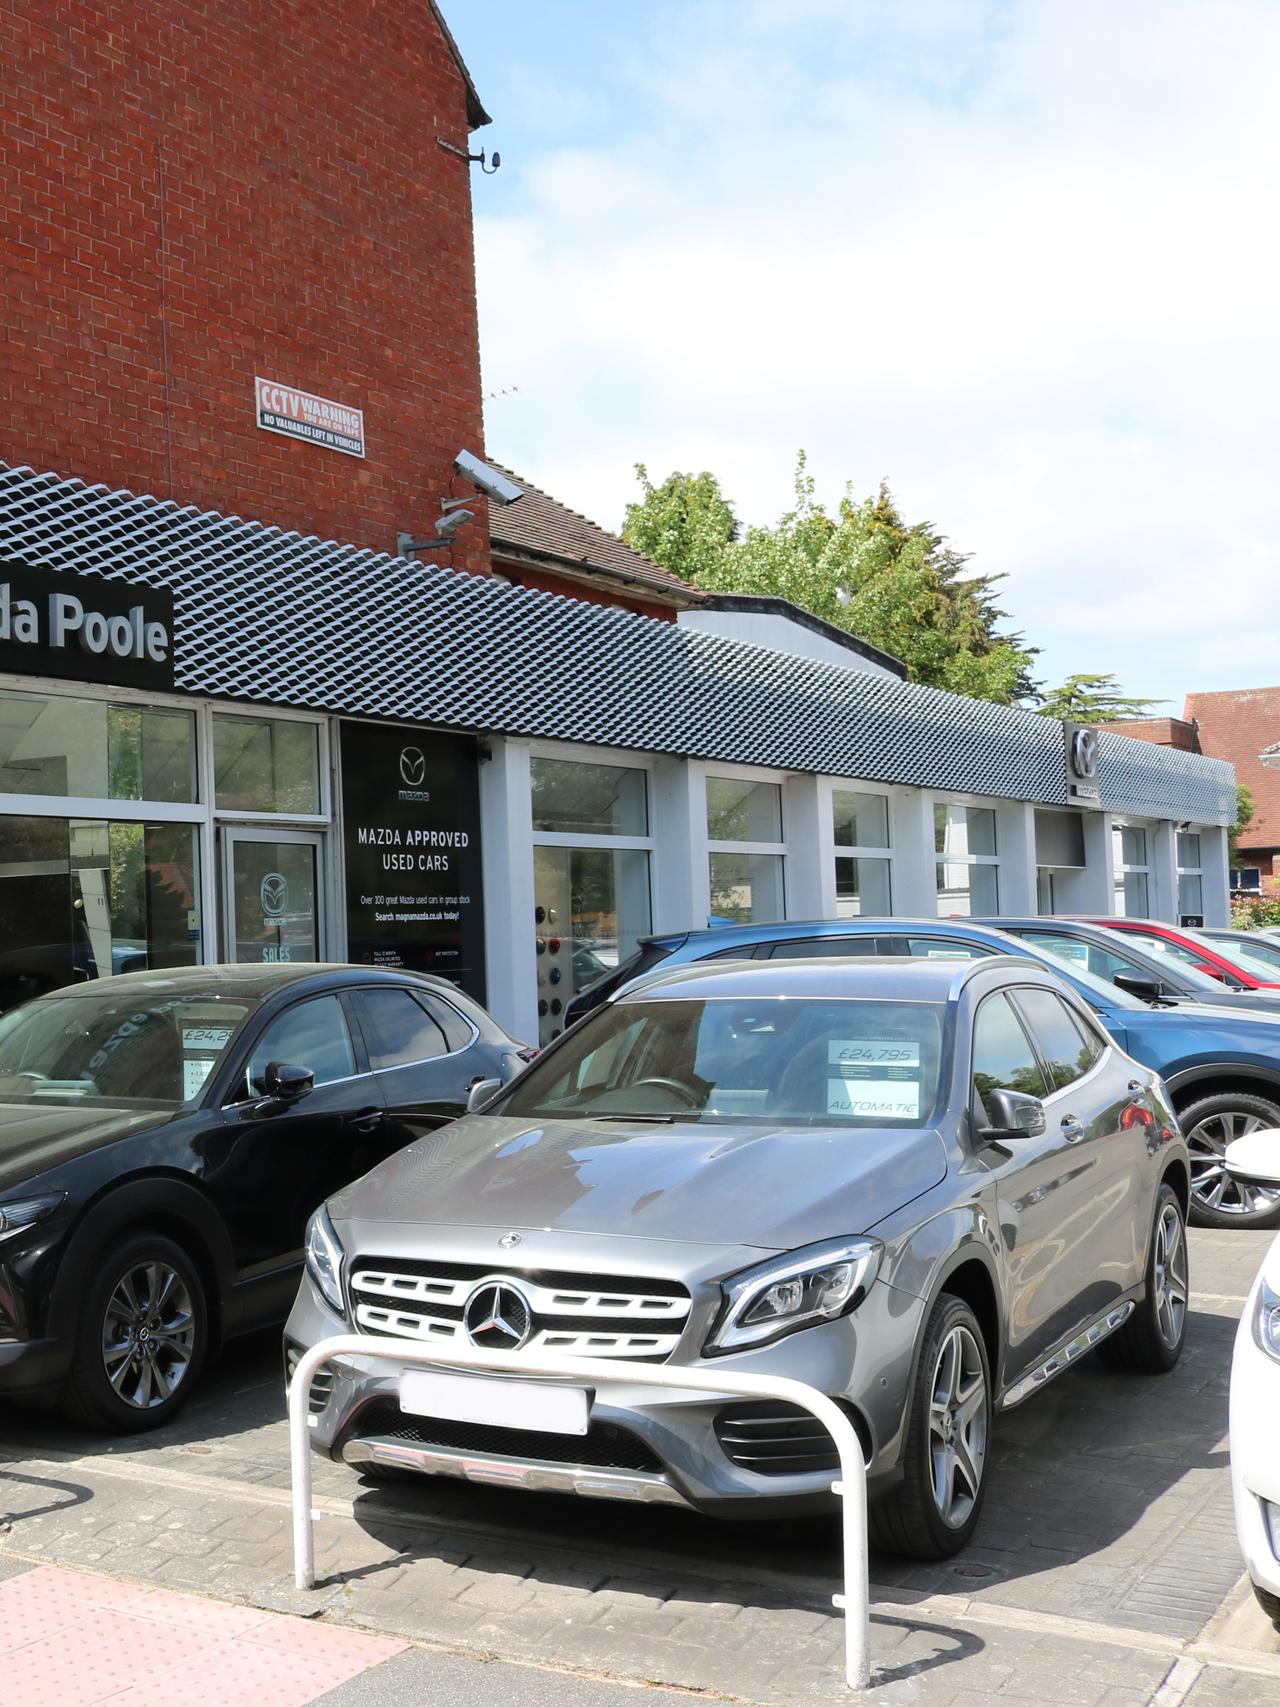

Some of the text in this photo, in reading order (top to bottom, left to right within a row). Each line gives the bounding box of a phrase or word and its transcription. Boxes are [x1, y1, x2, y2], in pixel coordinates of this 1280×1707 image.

[261, 385, 359, 428] CCTV WARNING
[264, 413, 361, 452] NO VALUABLES LEFT IN VEHICLES
[303, 412, 359, 437] YOU ARE ON TAPE
[49, 592, 168, 662] Poole
[358, 827, 469, 848] MAZDA APPROVED
[382, 853, 449, 871] USED CARS
[360, 895, 471, 907] Over 100 great Mazda used cars in group stock
[375, 911, 460, 923] Search magnamazda.co.uk today!
[262, 946, 290, 962] SALES
[837, 1048, 913, 1061] £24,795
